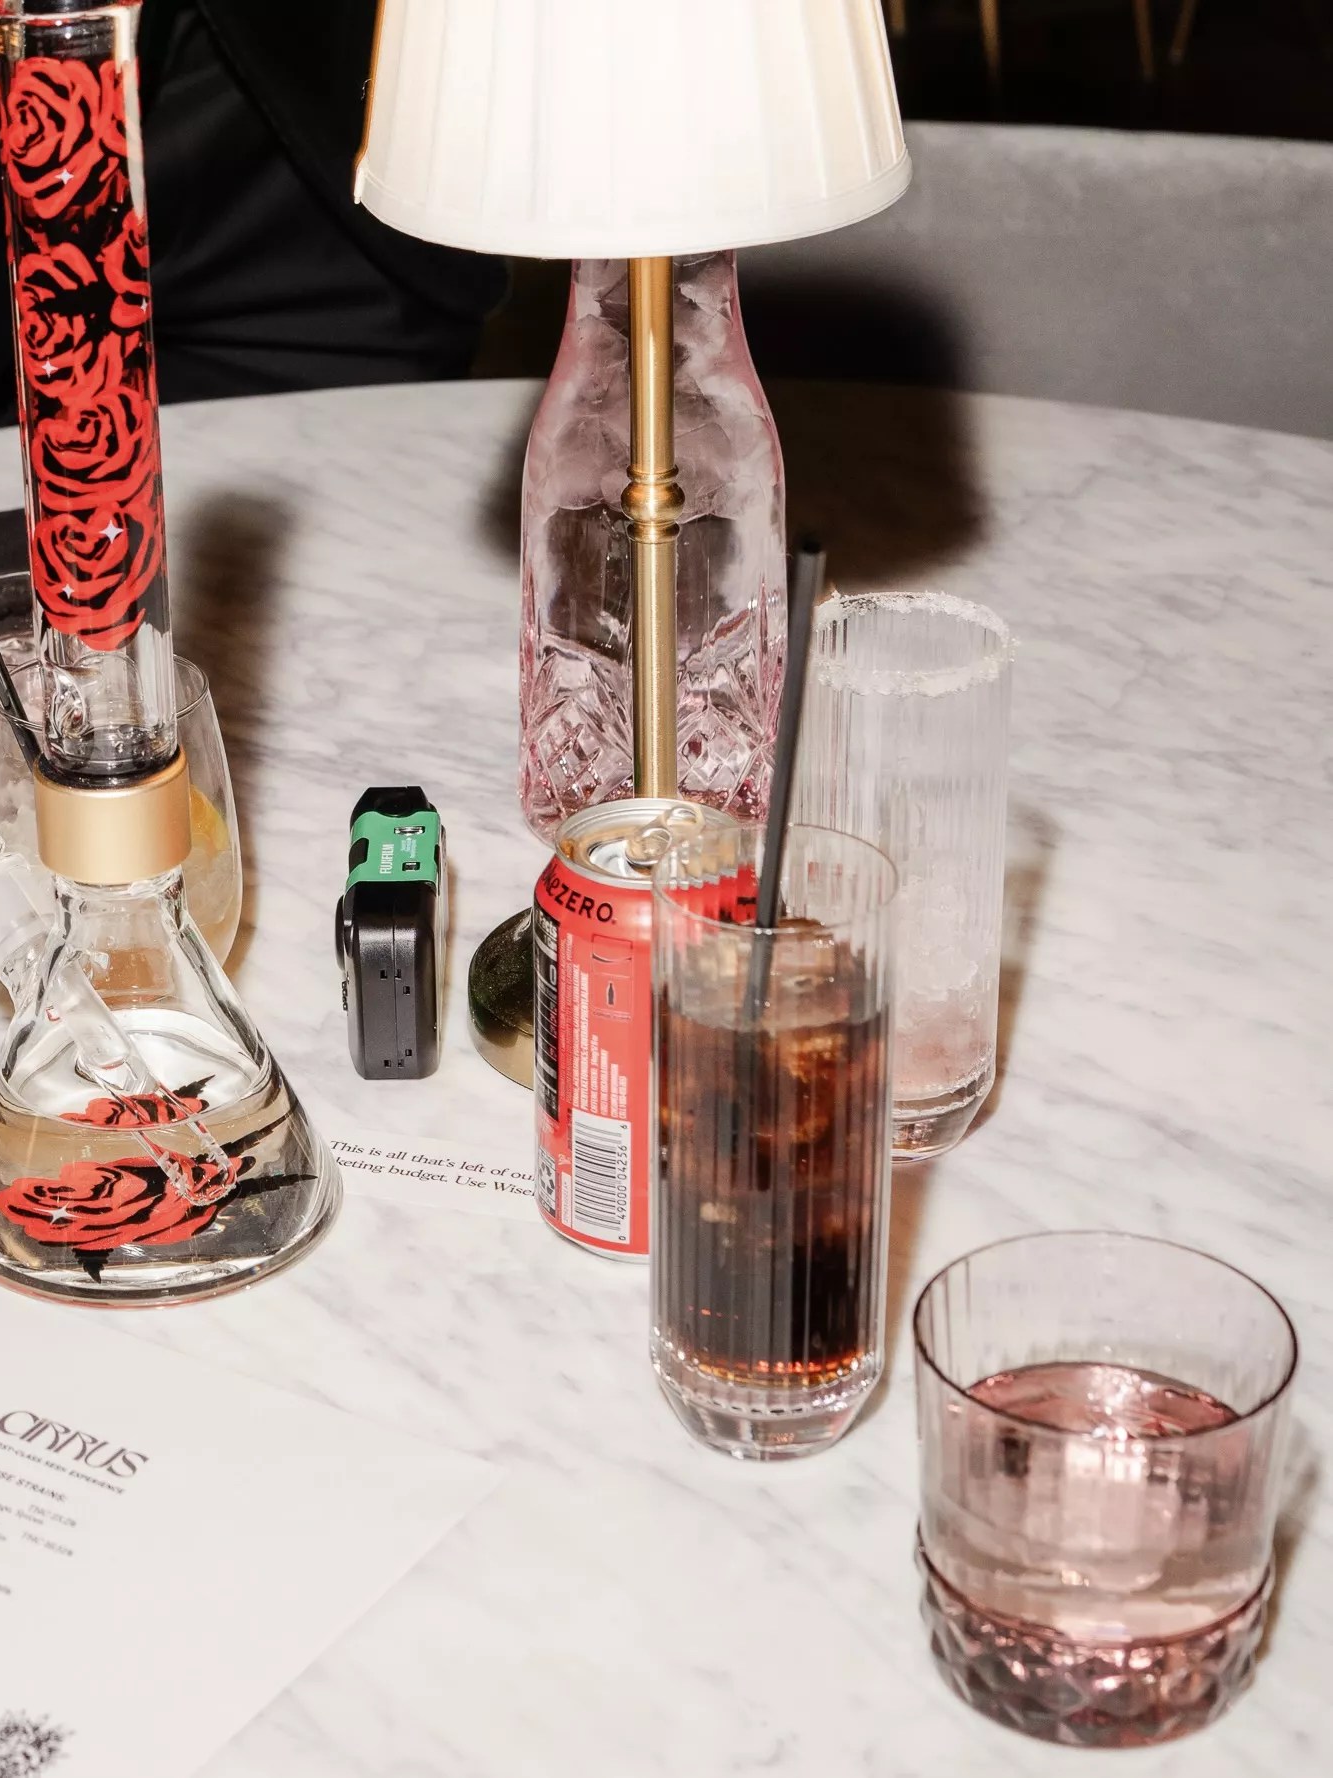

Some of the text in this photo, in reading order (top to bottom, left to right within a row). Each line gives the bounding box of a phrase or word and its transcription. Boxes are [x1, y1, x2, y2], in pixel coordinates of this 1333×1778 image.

[379, 844, 395, 875] FUJIFILM
[331, 1140, 364, 1153] This
[369, 1147, 381, 1155] is
[386, 1151, 407, 1160] all
[411, 1154, 455, 1167] that's
[459, 1161, 484, 1172] left
[490, 1168, 509, 1176] of
[336, 1157, 385, 1173] keting
[388, 1165, 447, 1182] budget.
[455, 1175, 486, 1188] Use
[617, 1145, 627, 1180] 04256
[617, 1186, 627, 1220] 49000
